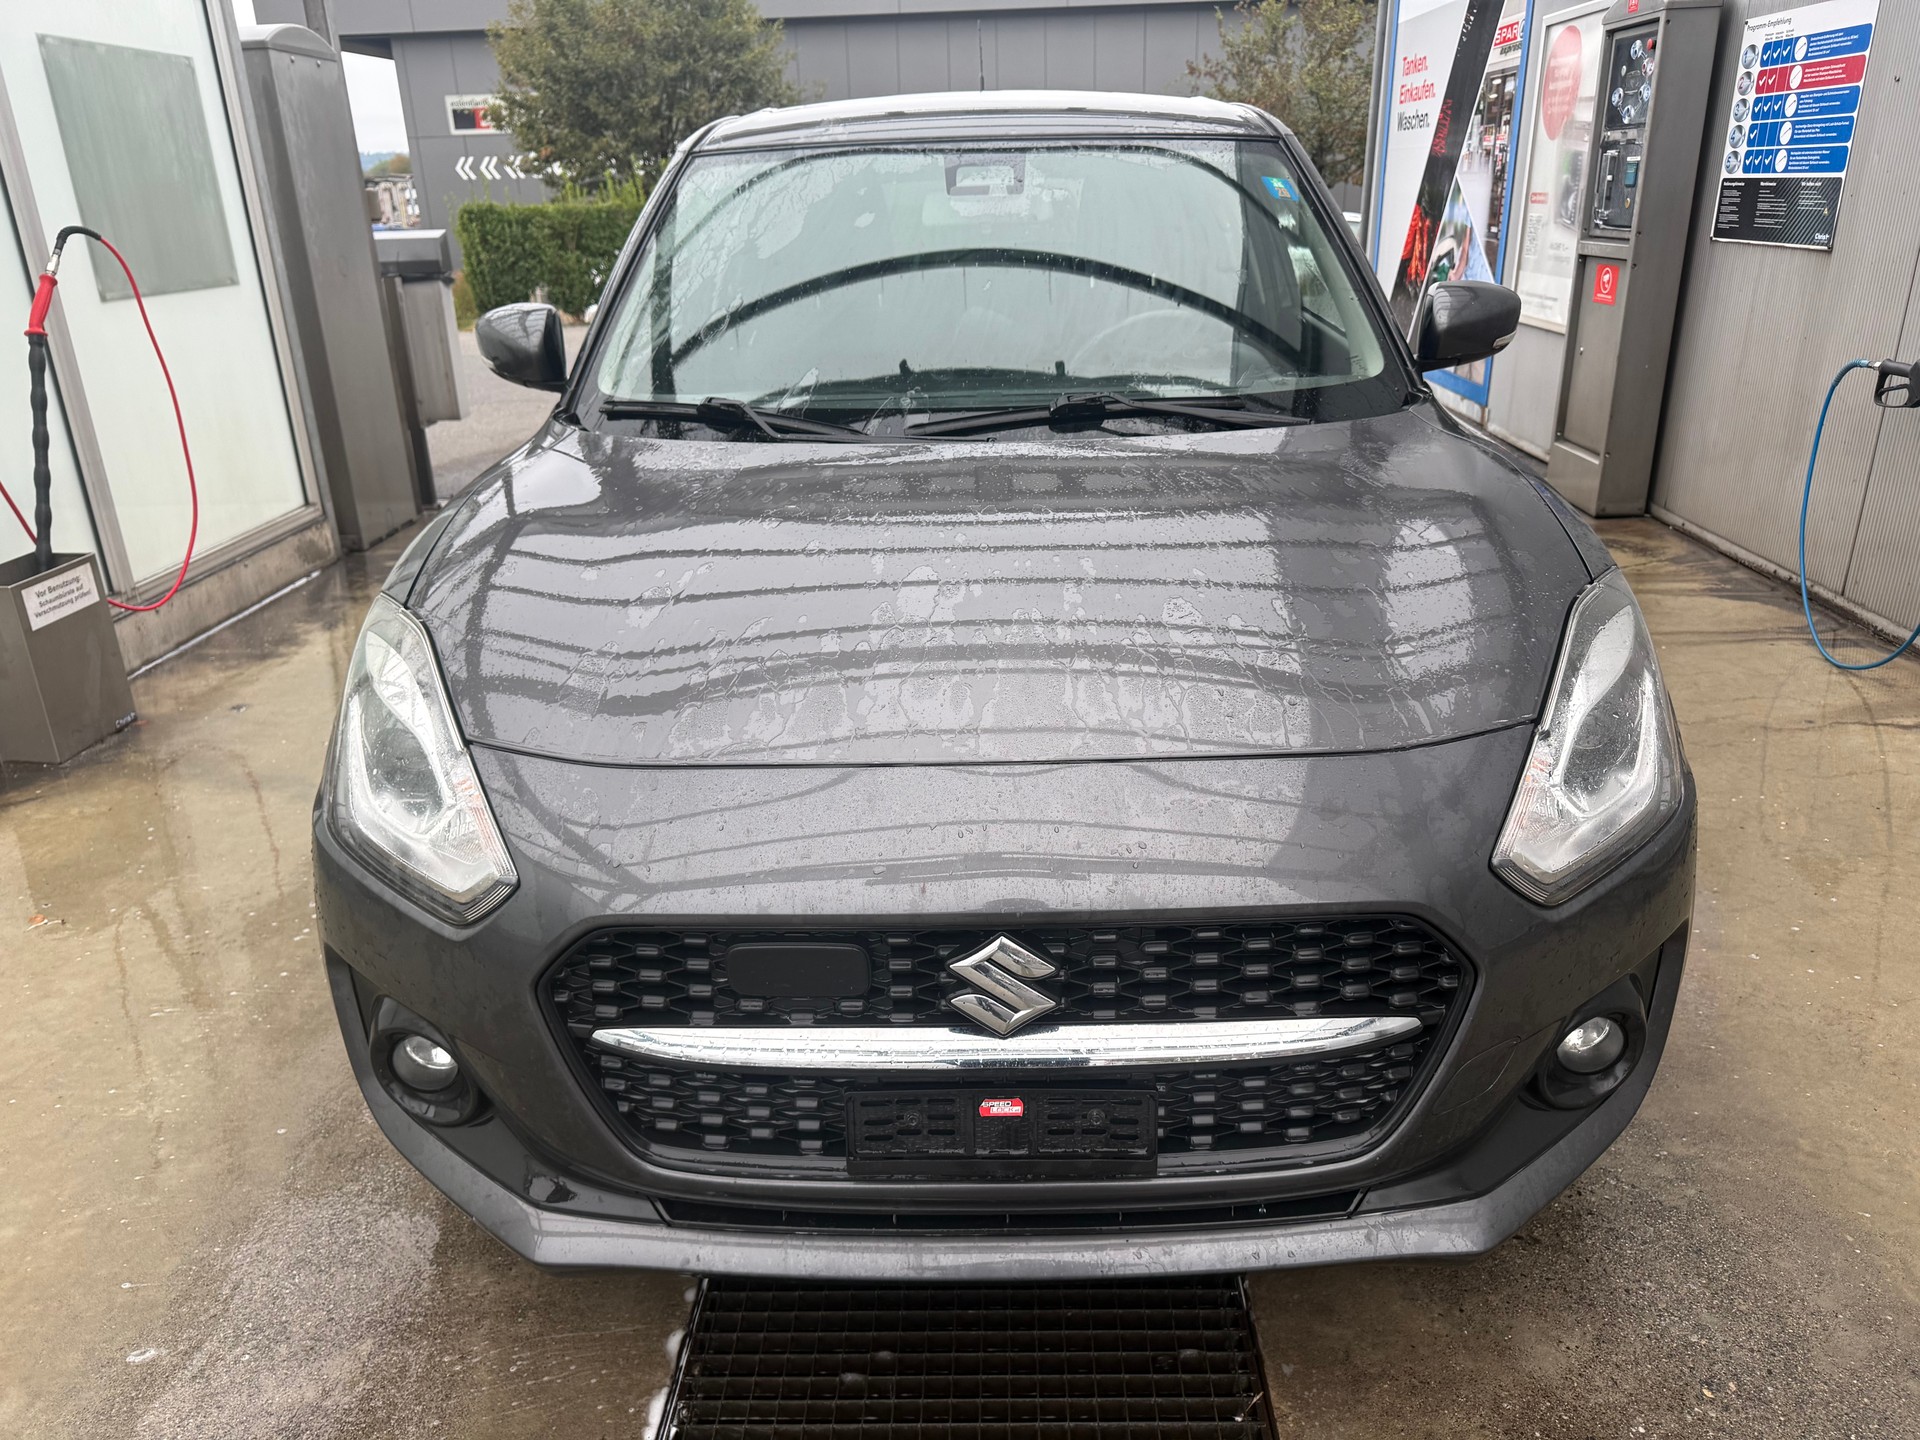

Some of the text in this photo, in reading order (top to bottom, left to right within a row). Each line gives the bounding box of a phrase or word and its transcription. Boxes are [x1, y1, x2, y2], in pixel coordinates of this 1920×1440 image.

[1495, 26, 1518, 44] SPAR
[1402, 54, 1428, 77] Tanken.
[1399, 79, 1436, 105] Einkaufen.
[1397, 110, 1430, 132] Waschen.
[35, 575, 82, 598] Vor Benutzung:
[38, 583, 84, 608] Schaumbürste auf
[34, 598, 74, 618] Verschmutzung
